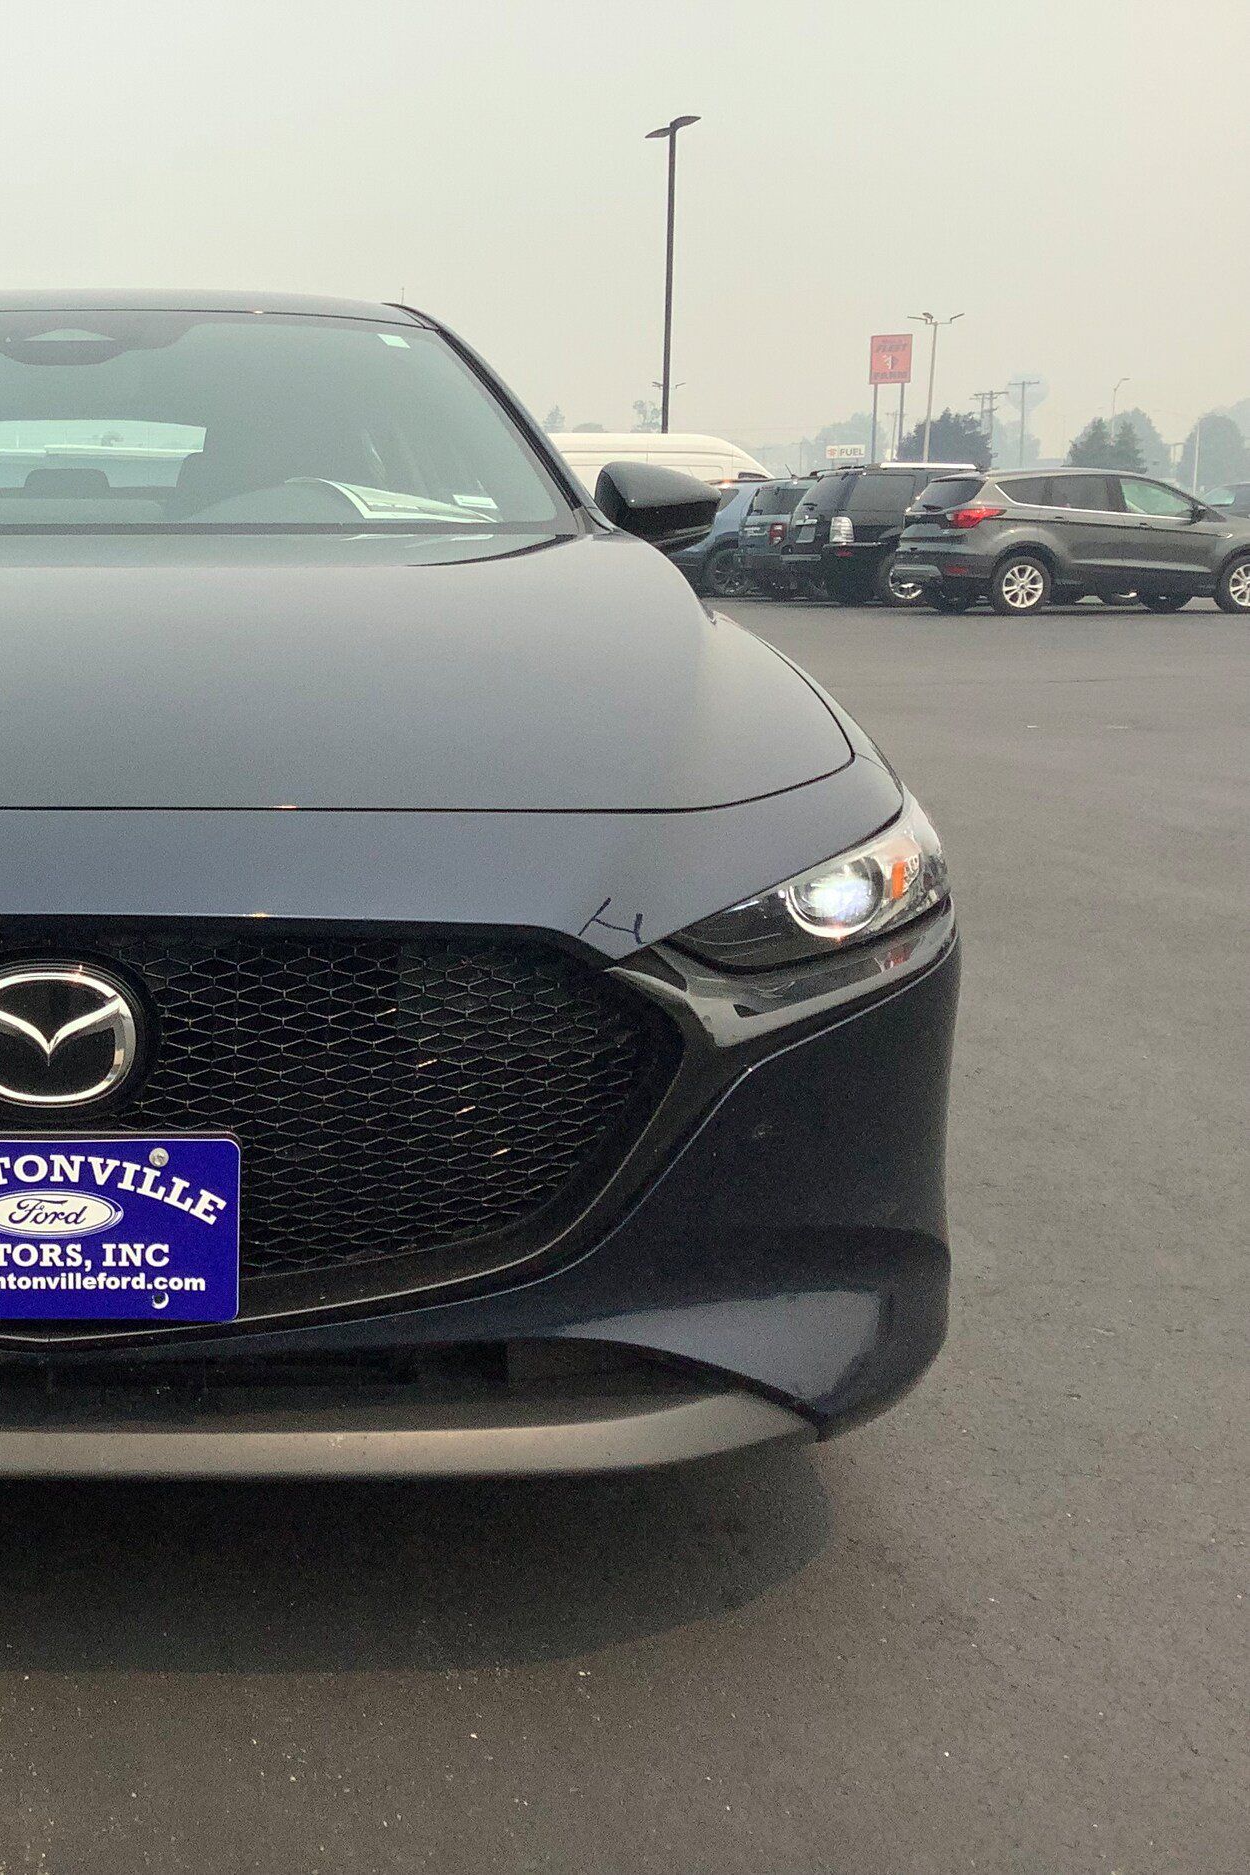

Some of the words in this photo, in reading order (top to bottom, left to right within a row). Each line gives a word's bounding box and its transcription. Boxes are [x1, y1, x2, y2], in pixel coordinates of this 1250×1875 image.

[839, 448, 865, 457] FUEL
[8, 1198, 88, 1227] Ford
[101, 1243, 171, 1268] INC
